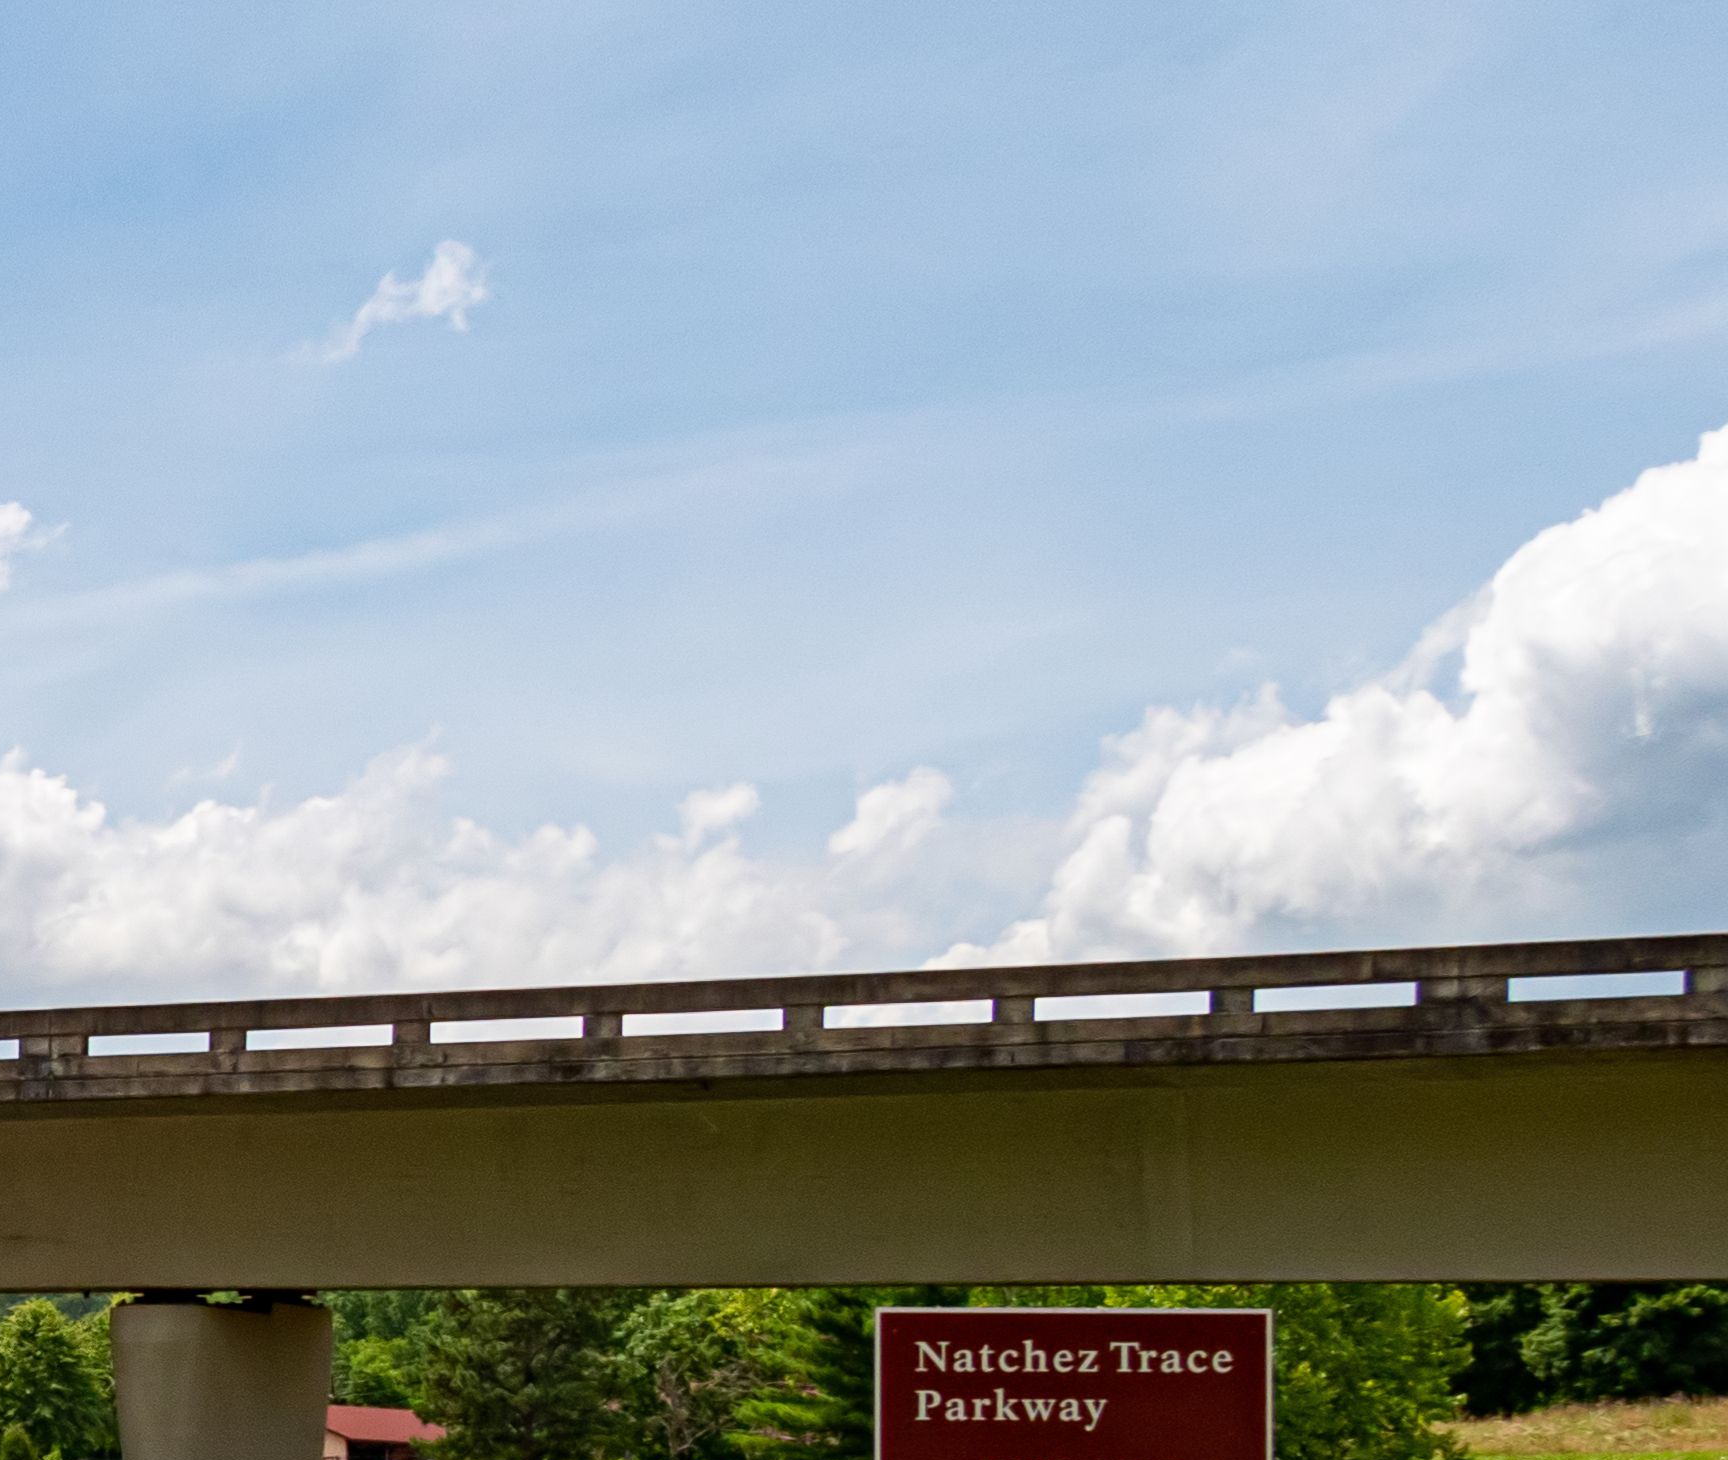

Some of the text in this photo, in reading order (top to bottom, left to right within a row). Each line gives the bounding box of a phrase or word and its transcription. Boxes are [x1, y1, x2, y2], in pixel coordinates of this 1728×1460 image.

[914, 1339, 1234, 1373] Natchez Trace
[914, 1388, 1108, 1431] Parkway
